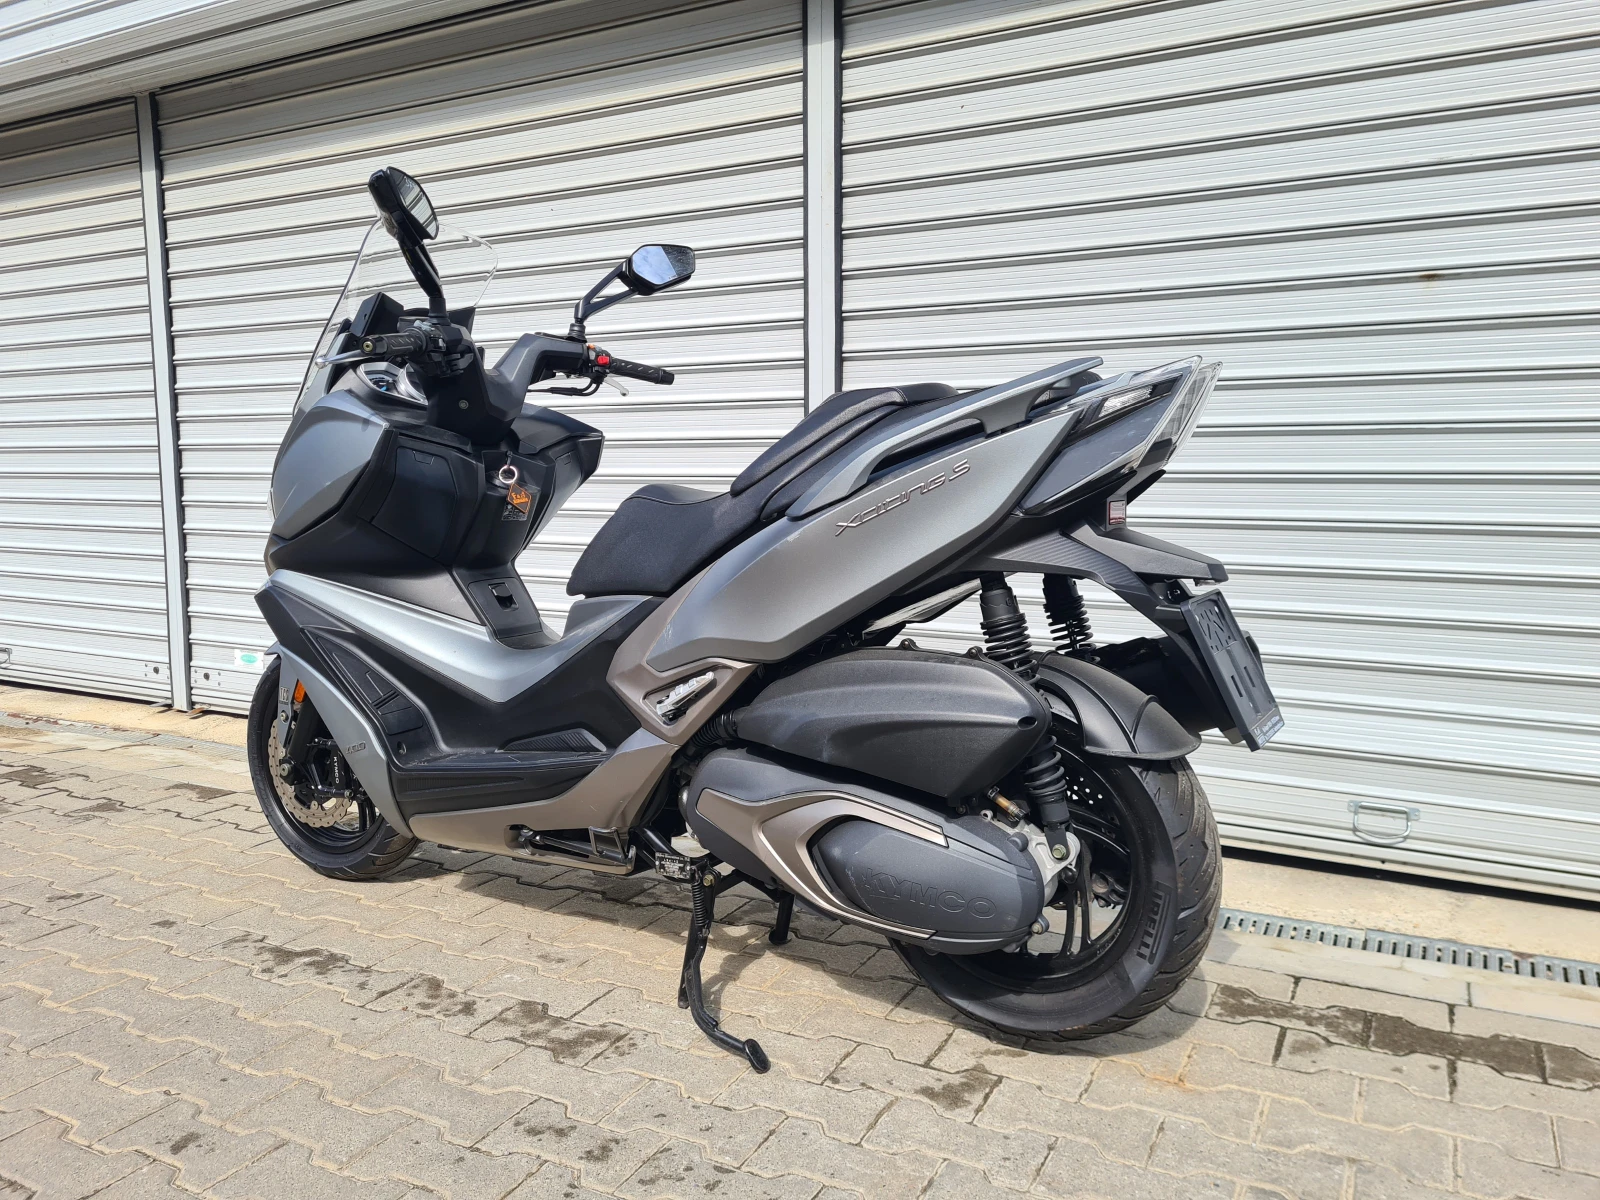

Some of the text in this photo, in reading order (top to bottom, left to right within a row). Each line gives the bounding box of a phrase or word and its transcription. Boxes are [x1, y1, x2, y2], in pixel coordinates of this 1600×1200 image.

[949, 459, 970, 481] S
[346, 741, 366, 754] 400
[862, 868, 997, 919] KYMCO
